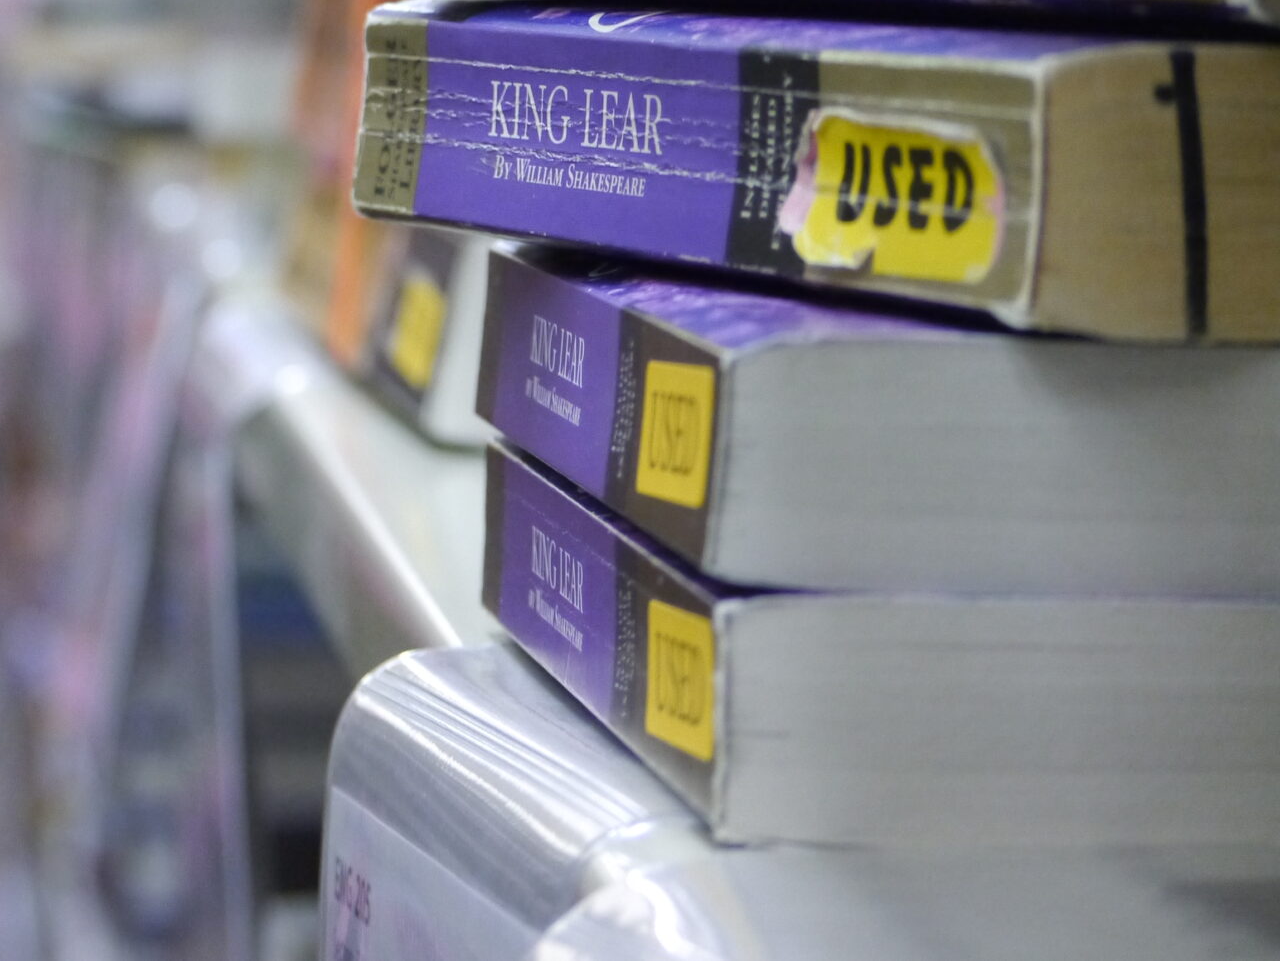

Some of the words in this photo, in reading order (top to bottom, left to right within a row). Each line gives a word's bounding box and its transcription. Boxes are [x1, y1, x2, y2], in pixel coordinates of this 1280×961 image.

[487, 80, 571, 145] KING
[580, 88, 663, 155] LEAR
[493, 154, 512, 181] BY
[515, 158, 564, 187] WILLIAM
[565, 163, 647, 198] SHAKESPEARE
[835, 141, 975, 233] USED
[530, 314, 558, 373] KING
[557, 327, 585, 389] LEAR
[531, 525, 557, 590] KING
[559, 546, 584, 615] LEAR
